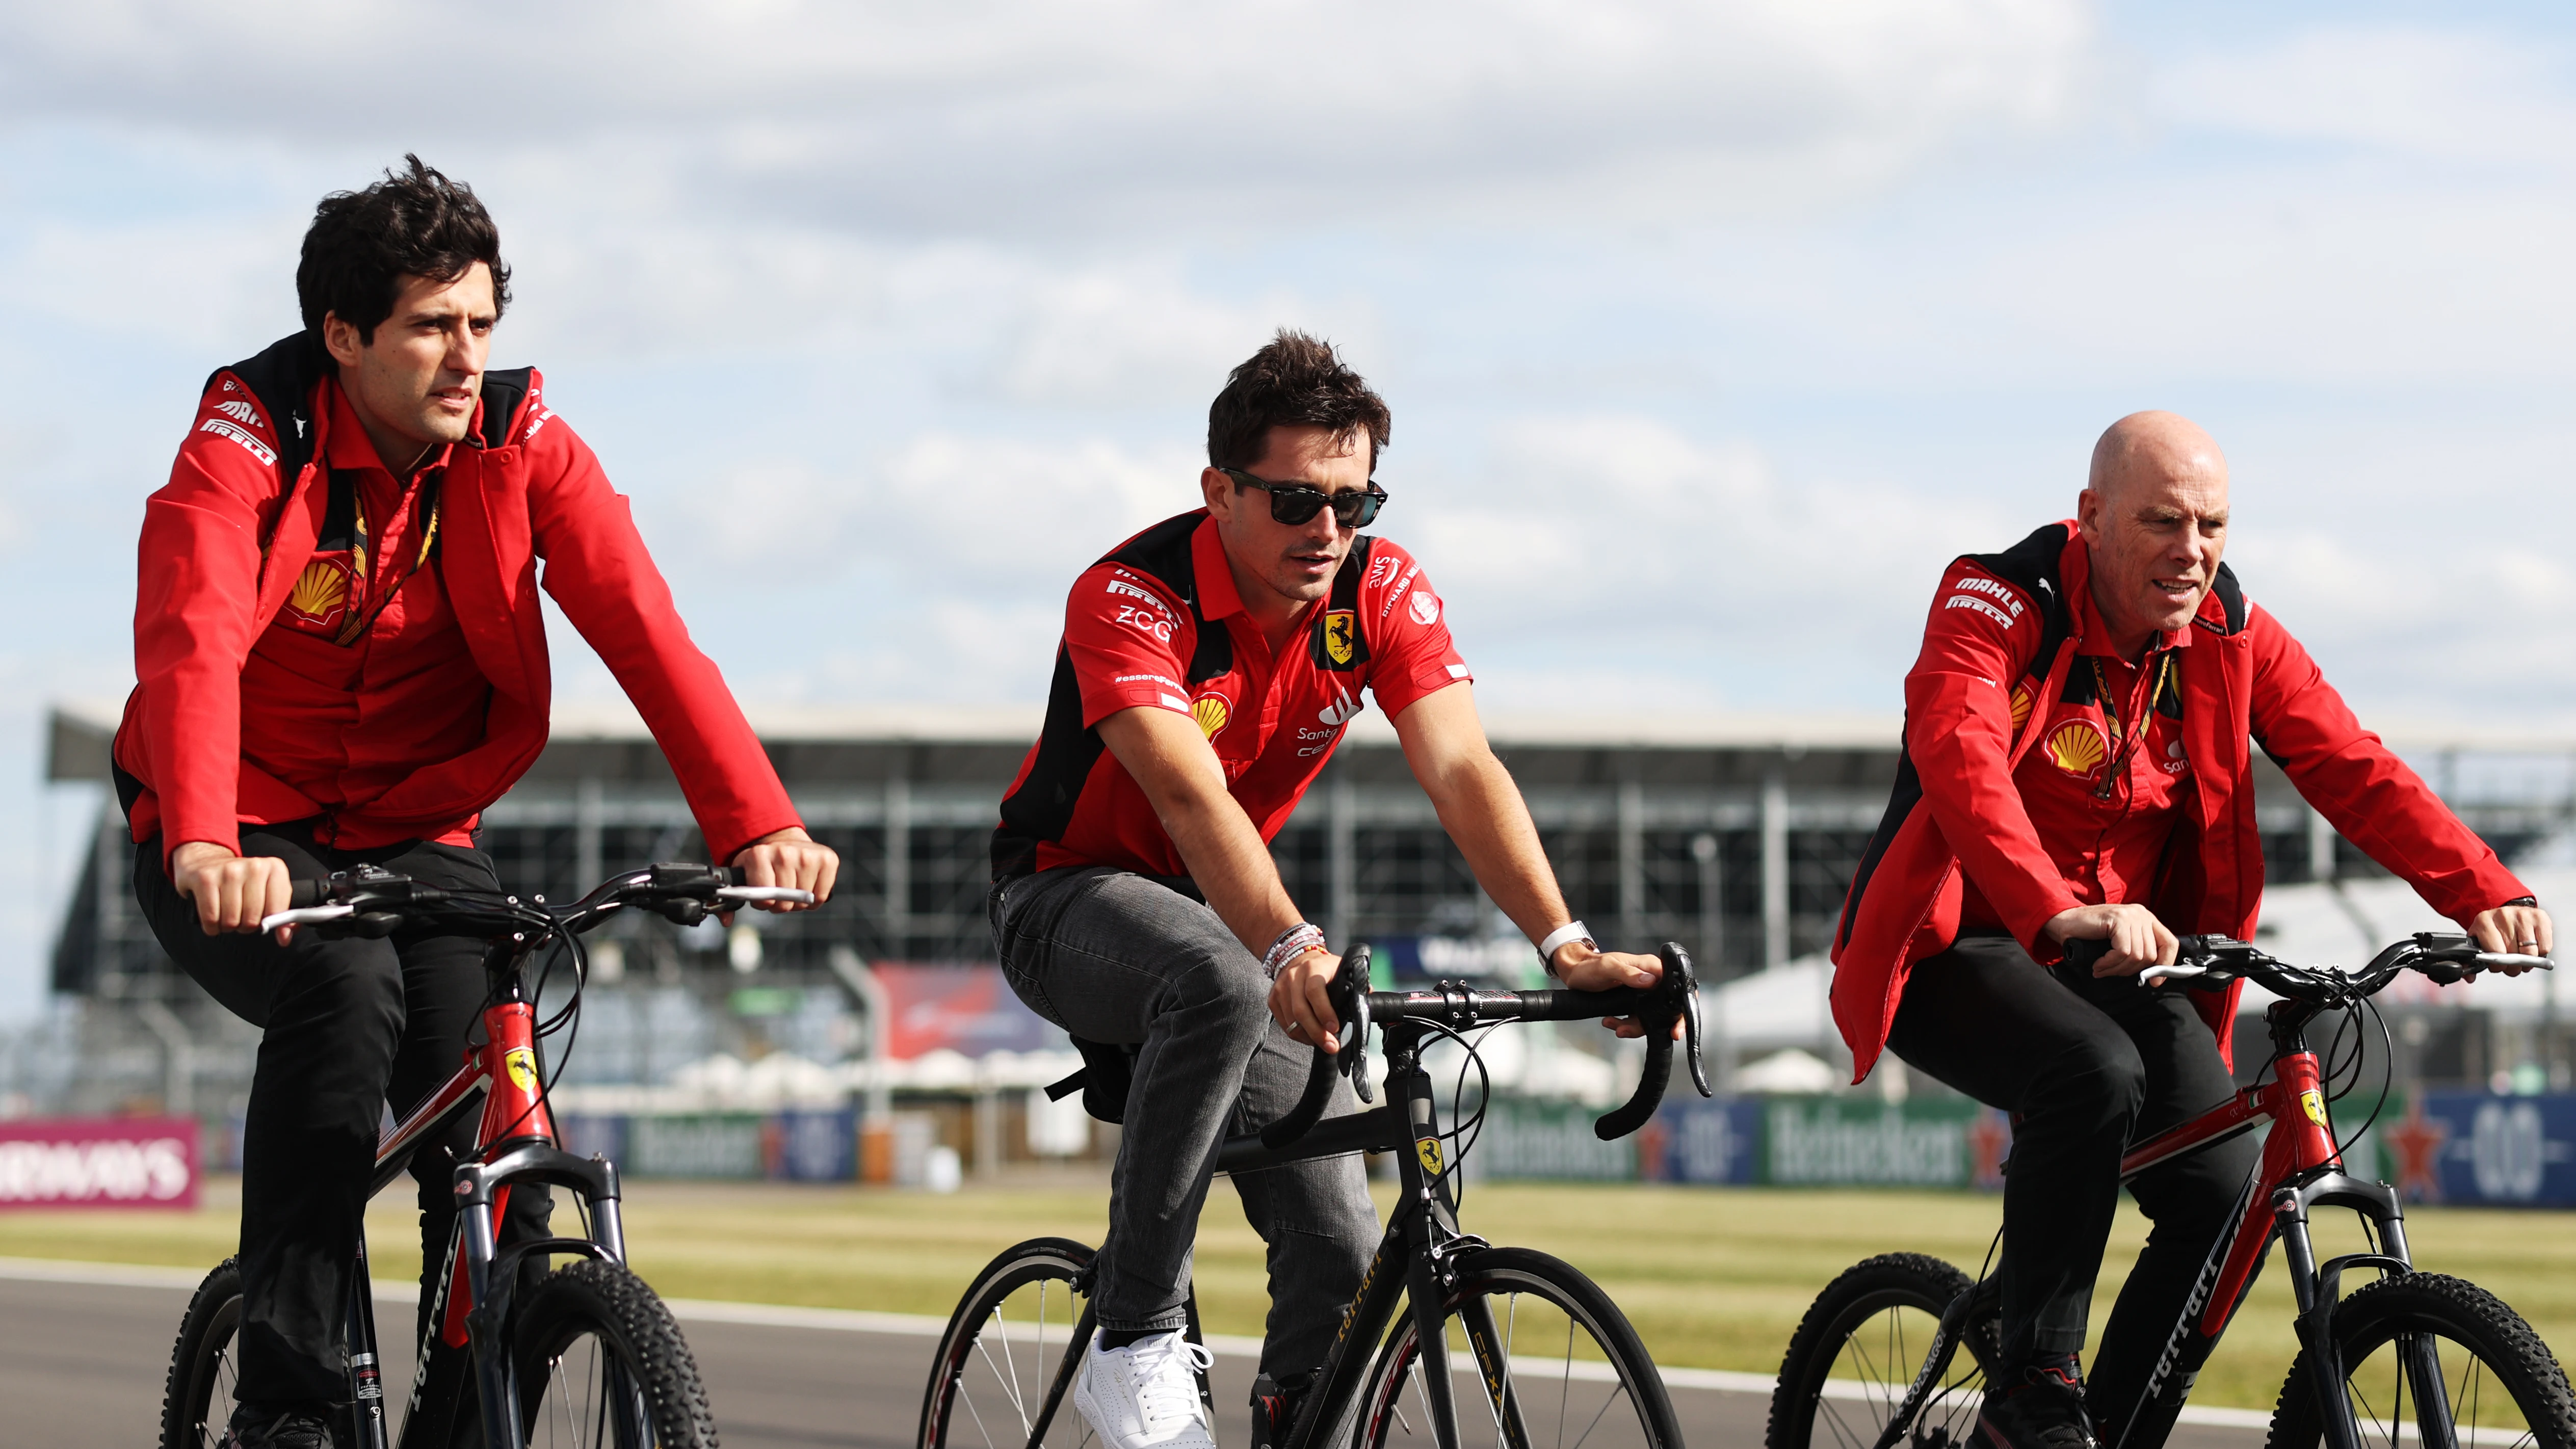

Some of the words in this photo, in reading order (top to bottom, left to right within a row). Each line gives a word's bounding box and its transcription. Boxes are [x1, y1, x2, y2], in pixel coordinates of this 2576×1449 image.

[199, 418, 278, 466] PIRELLI
[1369, 556, 1390, 589] aws
[1382, 577, 1410, 618] RICHARD
[1945, 595, 2014, 630] PIRELLI
[1955, 577, 2024, 618] MAHLE
[1116, 605, 1172, 643] ZCG
[1905, 1334, 1943, 1405] COLNAGO
